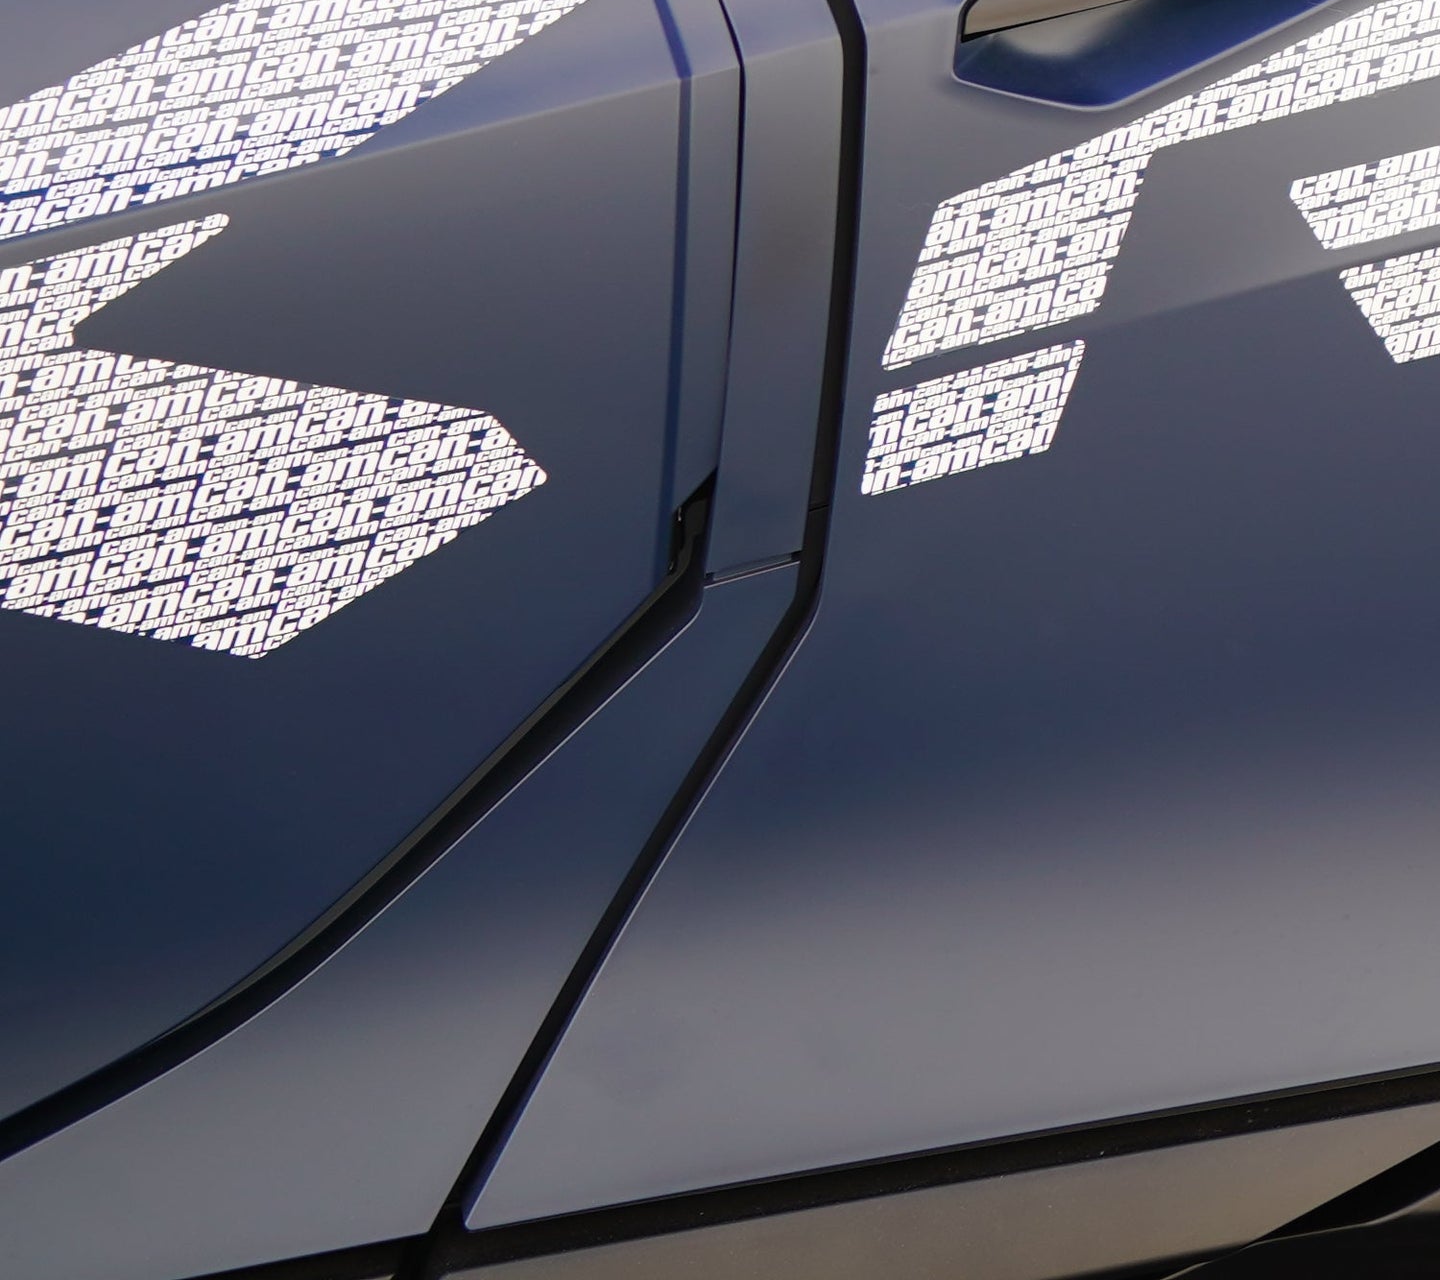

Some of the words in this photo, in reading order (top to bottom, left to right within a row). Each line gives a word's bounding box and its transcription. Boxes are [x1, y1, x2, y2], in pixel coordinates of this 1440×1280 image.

[57, 62, 247, 118] can-am
[246, 32, 431, 83] can-am
[142, 102, 331, 156] can-am
[1139, 84, 1292, 139] can-am
[892, 291, 1051, 347] can-am
[6, 384, 205, 452] can-am
[901, 379, 1060, 435] can-am
[102, 416, 293, 484] can-am
[0, 486, 191, 554] can-am
[194, 446, 378, 513] can-am
[89, 517, 280, 586] can-am
[278, 478, 462, 542] can-am
[180, 548, 364, 612] can-am
